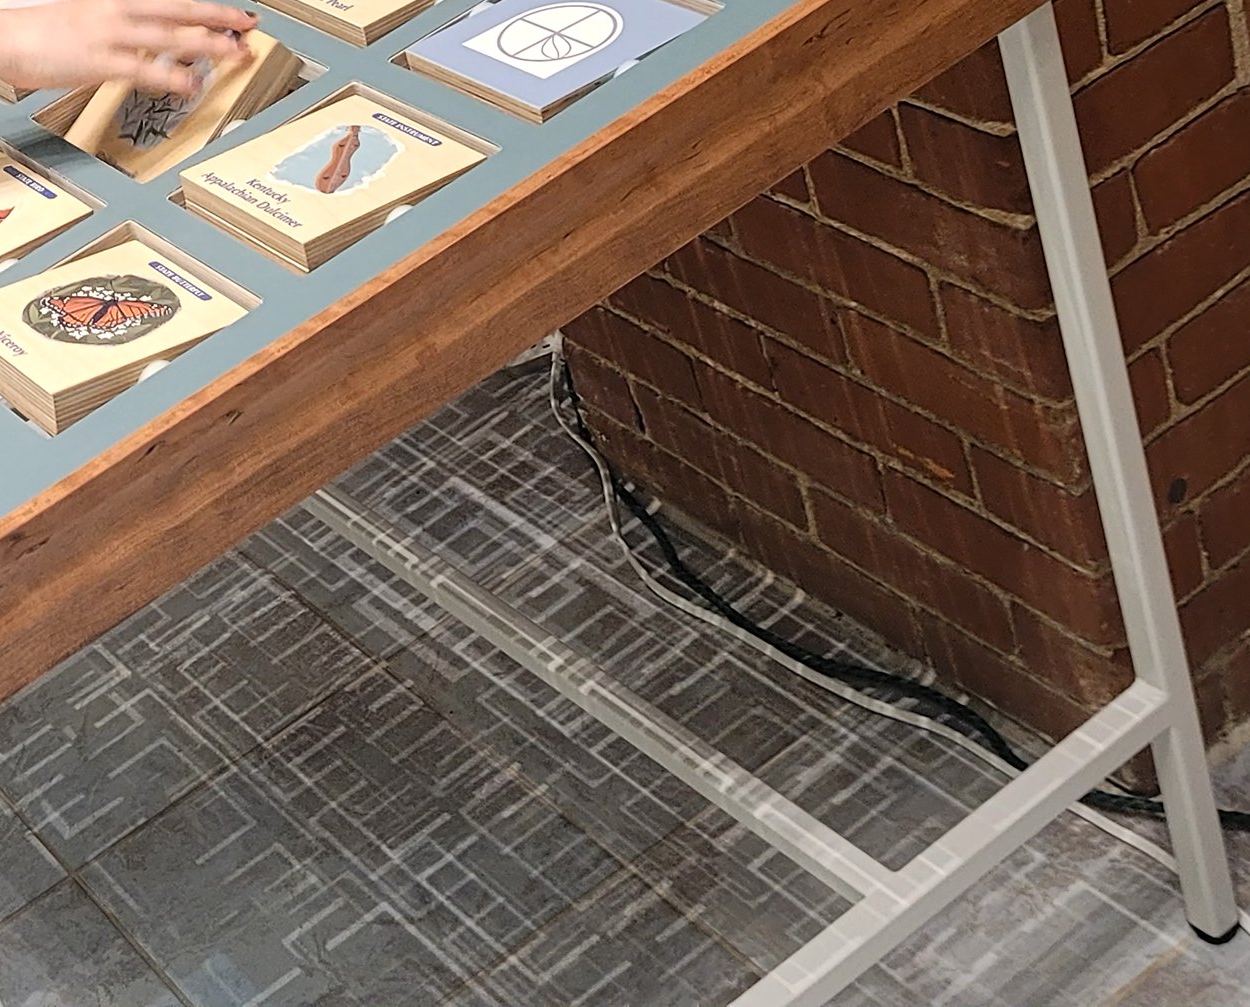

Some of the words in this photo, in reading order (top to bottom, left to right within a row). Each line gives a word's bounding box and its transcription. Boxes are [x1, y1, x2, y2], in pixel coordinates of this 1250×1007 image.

[377, 114, 398, 126] STATE
[201, 172, 258, 204] Appalachian
[256, 200, 303, 228] Dulcimer
[246, 178, 291, 205] Kentucky
